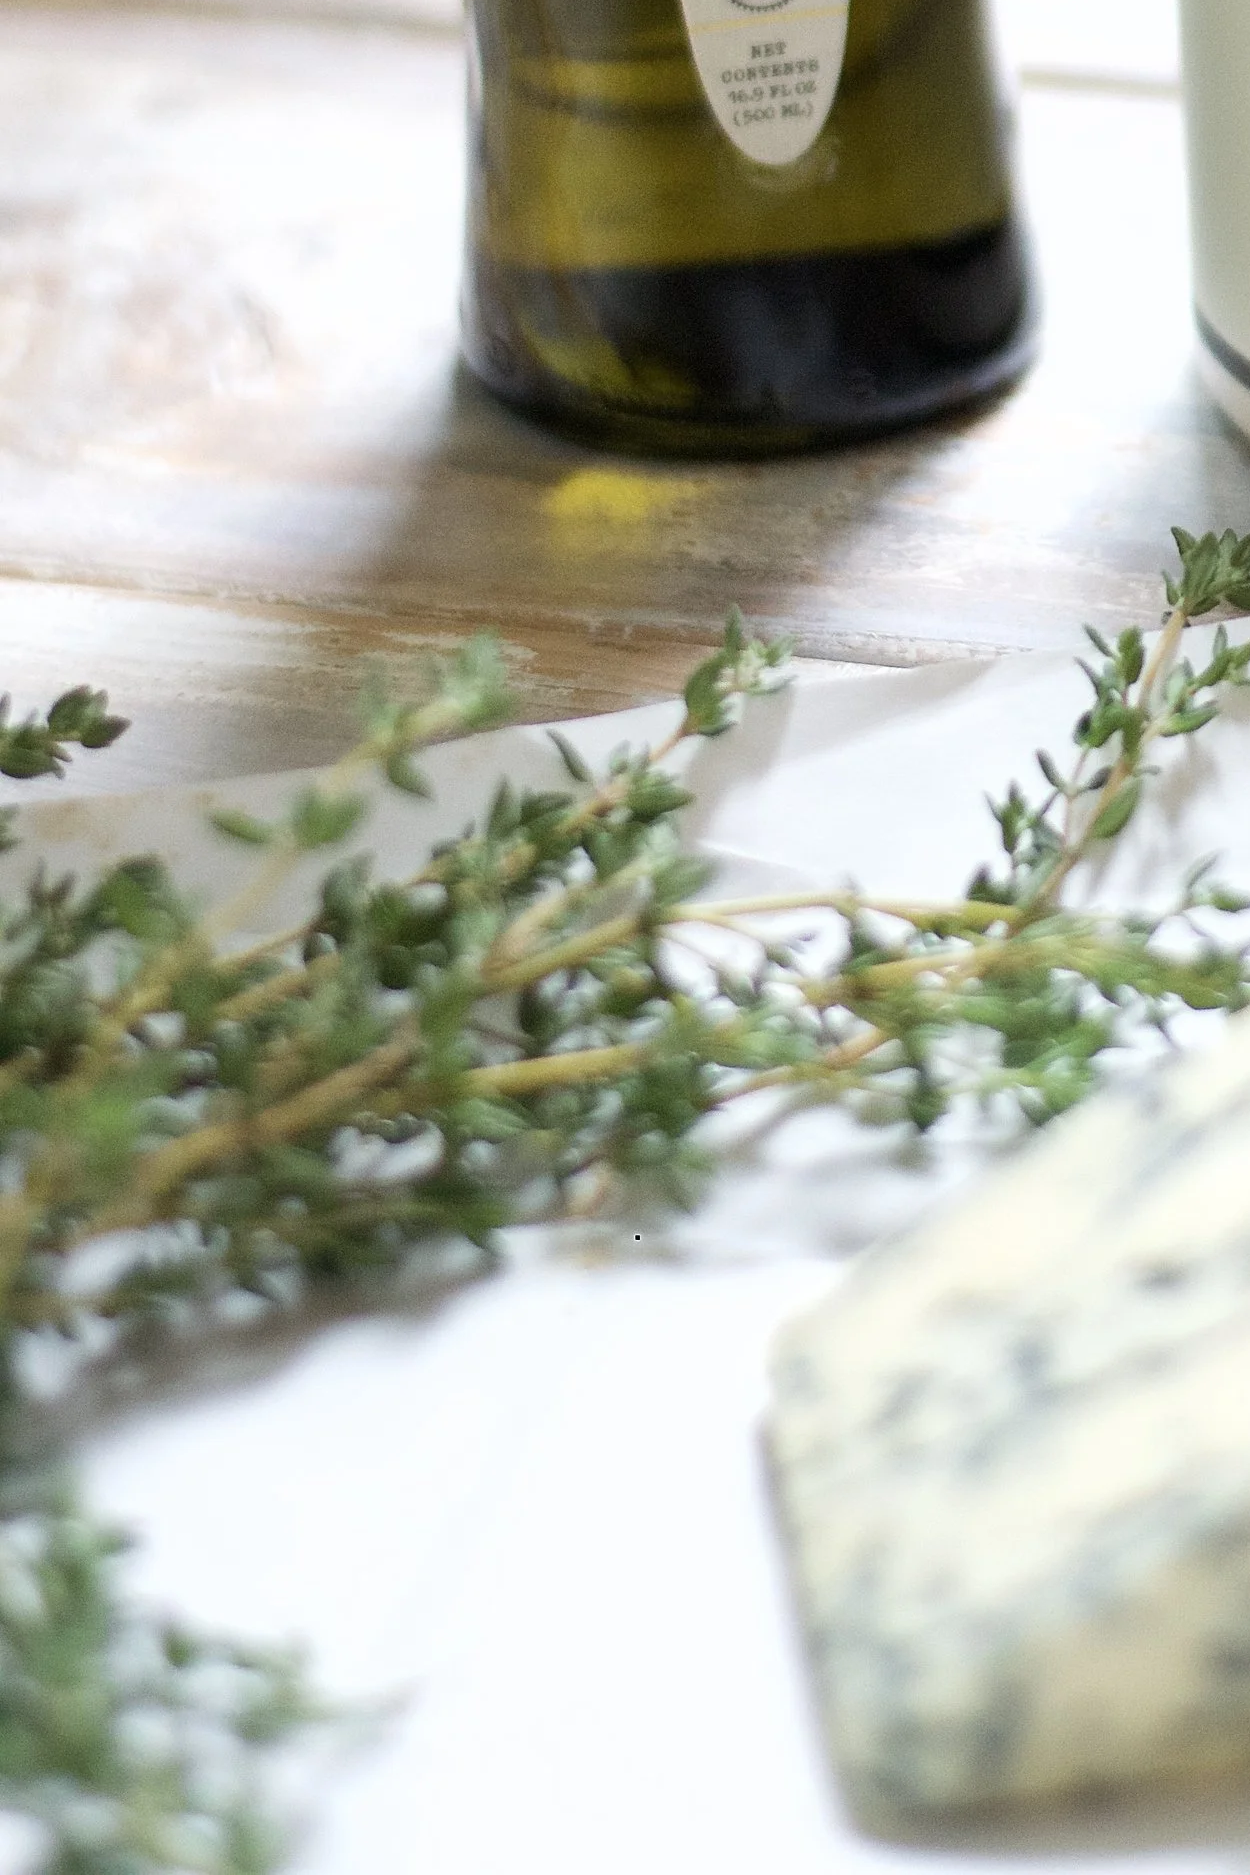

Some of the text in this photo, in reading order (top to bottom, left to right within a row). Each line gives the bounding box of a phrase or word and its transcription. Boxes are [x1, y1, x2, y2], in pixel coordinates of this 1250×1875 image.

[751, 39, 786, 59] NET
[721, 59, 819, 84] CONTENTS
[769, 84, 792, 99] FL
